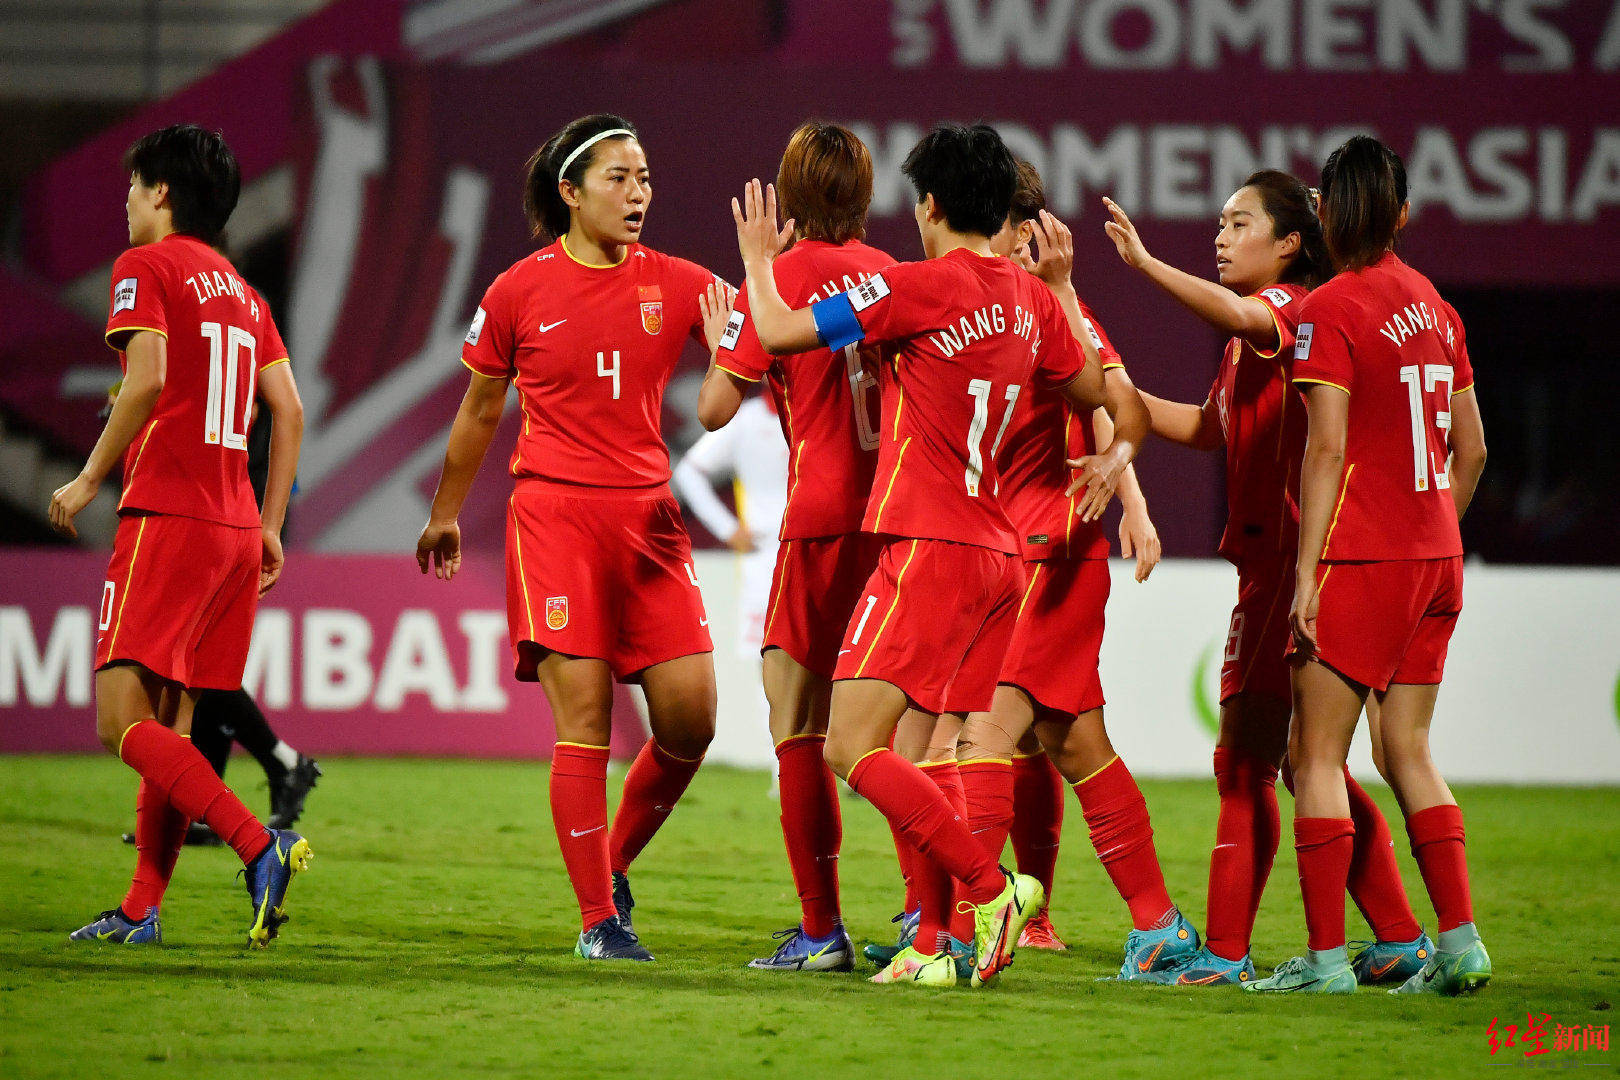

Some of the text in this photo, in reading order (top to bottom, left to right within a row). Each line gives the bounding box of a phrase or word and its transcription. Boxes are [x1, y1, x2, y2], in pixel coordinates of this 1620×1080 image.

[848, 121, 1379, 218] WMEN'
[186, 270, 246, 305] ZHANG
[1379, 301, 1433, 348] YANG
[928, 303, 1006, 358] WANG
[200, 321, 257, 451] 10
[596, 350, 620, 400] 4
[964, 378, 1021, 498] 11
[1399, 363, 1454, 492] 13
[851, 594, 879, 646] 1
[0, 606, 508, 711] MBAI
